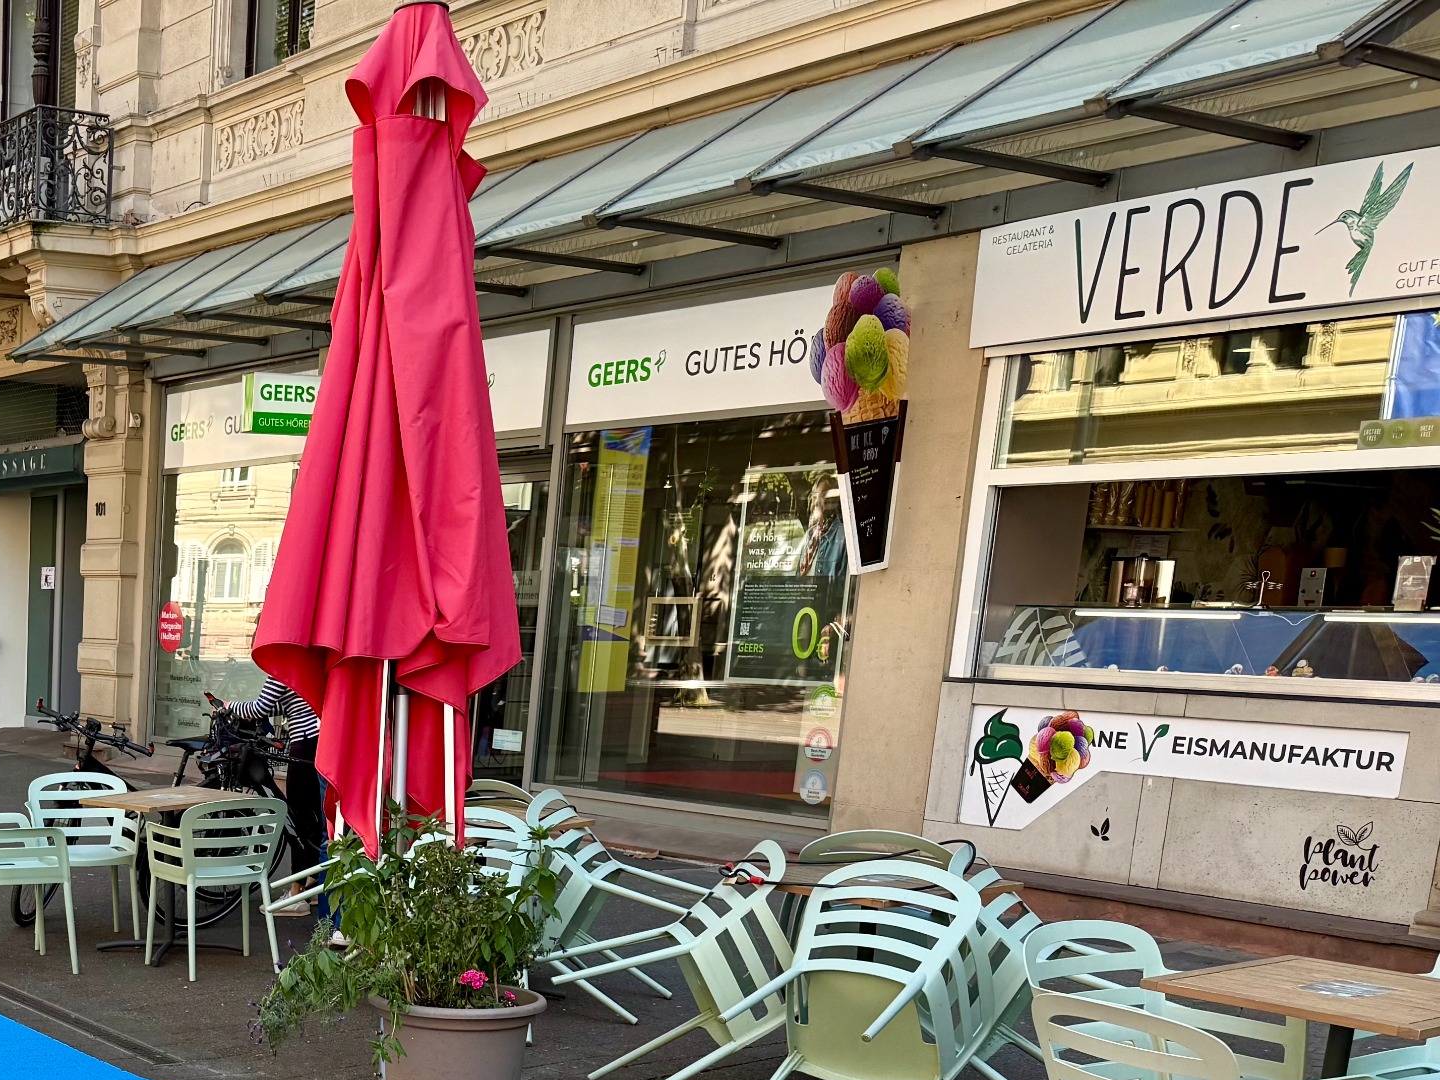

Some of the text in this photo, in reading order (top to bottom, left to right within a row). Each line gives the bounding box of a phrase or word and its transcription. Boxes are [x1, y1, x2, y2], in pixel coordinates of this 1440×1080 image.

[992, 224, 1055, 246] RESTAURANT &
[1005, 238, 1054, 257] GELATERIA
[1074, 177, 1315, 325] VERDE
[1398, 258, 1440, 274] GUT F
[1395, 276, 1426, 289] GUT
[587, 328, 815, 388] GEERS GUTES HÖ
[260, 384, 317, 403] GEERS
[170, 416, 242, 442] GEERS GU
[258, 417, 284, 428] GUTES
[95, 502, 106, 516] 101
[738, 642, 764, 653] GEERS
[1171, 736, 1396, 773] EISMANUFAKTUR
[1303, 834, 1380, 873] plant
[1298, 863, 1376, 892] power
